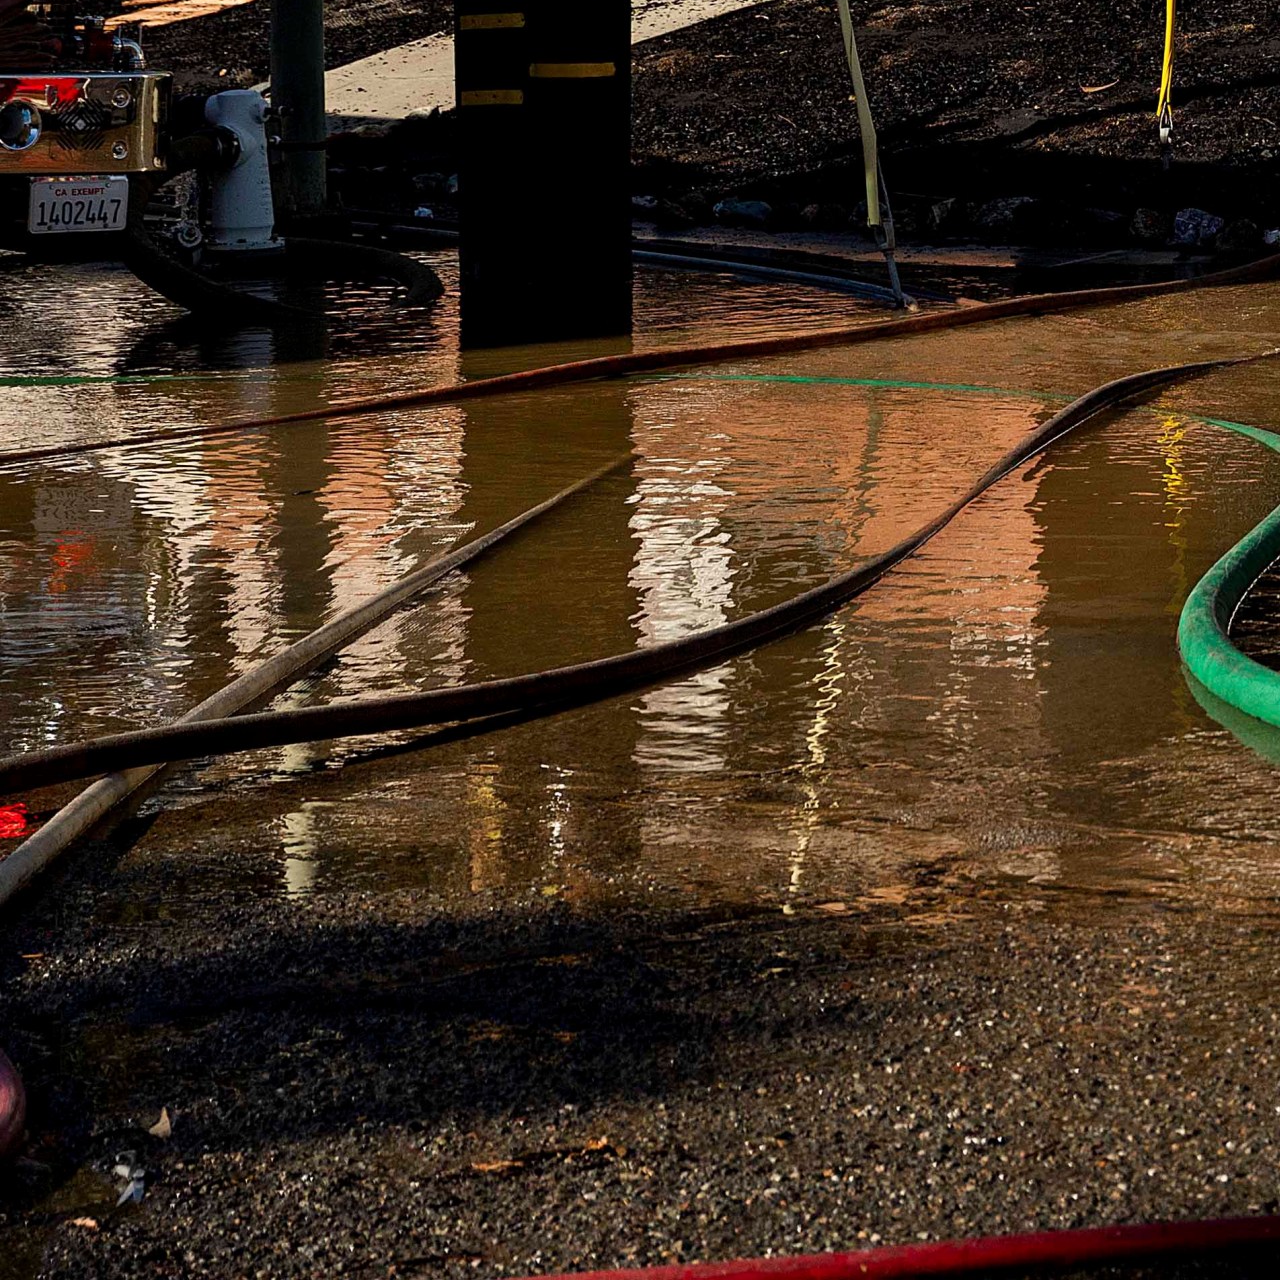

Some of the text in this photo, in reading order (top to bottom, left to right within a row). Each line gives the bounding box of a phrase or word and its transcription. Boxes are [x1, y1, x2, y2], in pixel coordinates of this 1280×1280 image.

[55, 187, 105, 197] CA EXEMPT
[36, 198, 122, 226] 1402447
